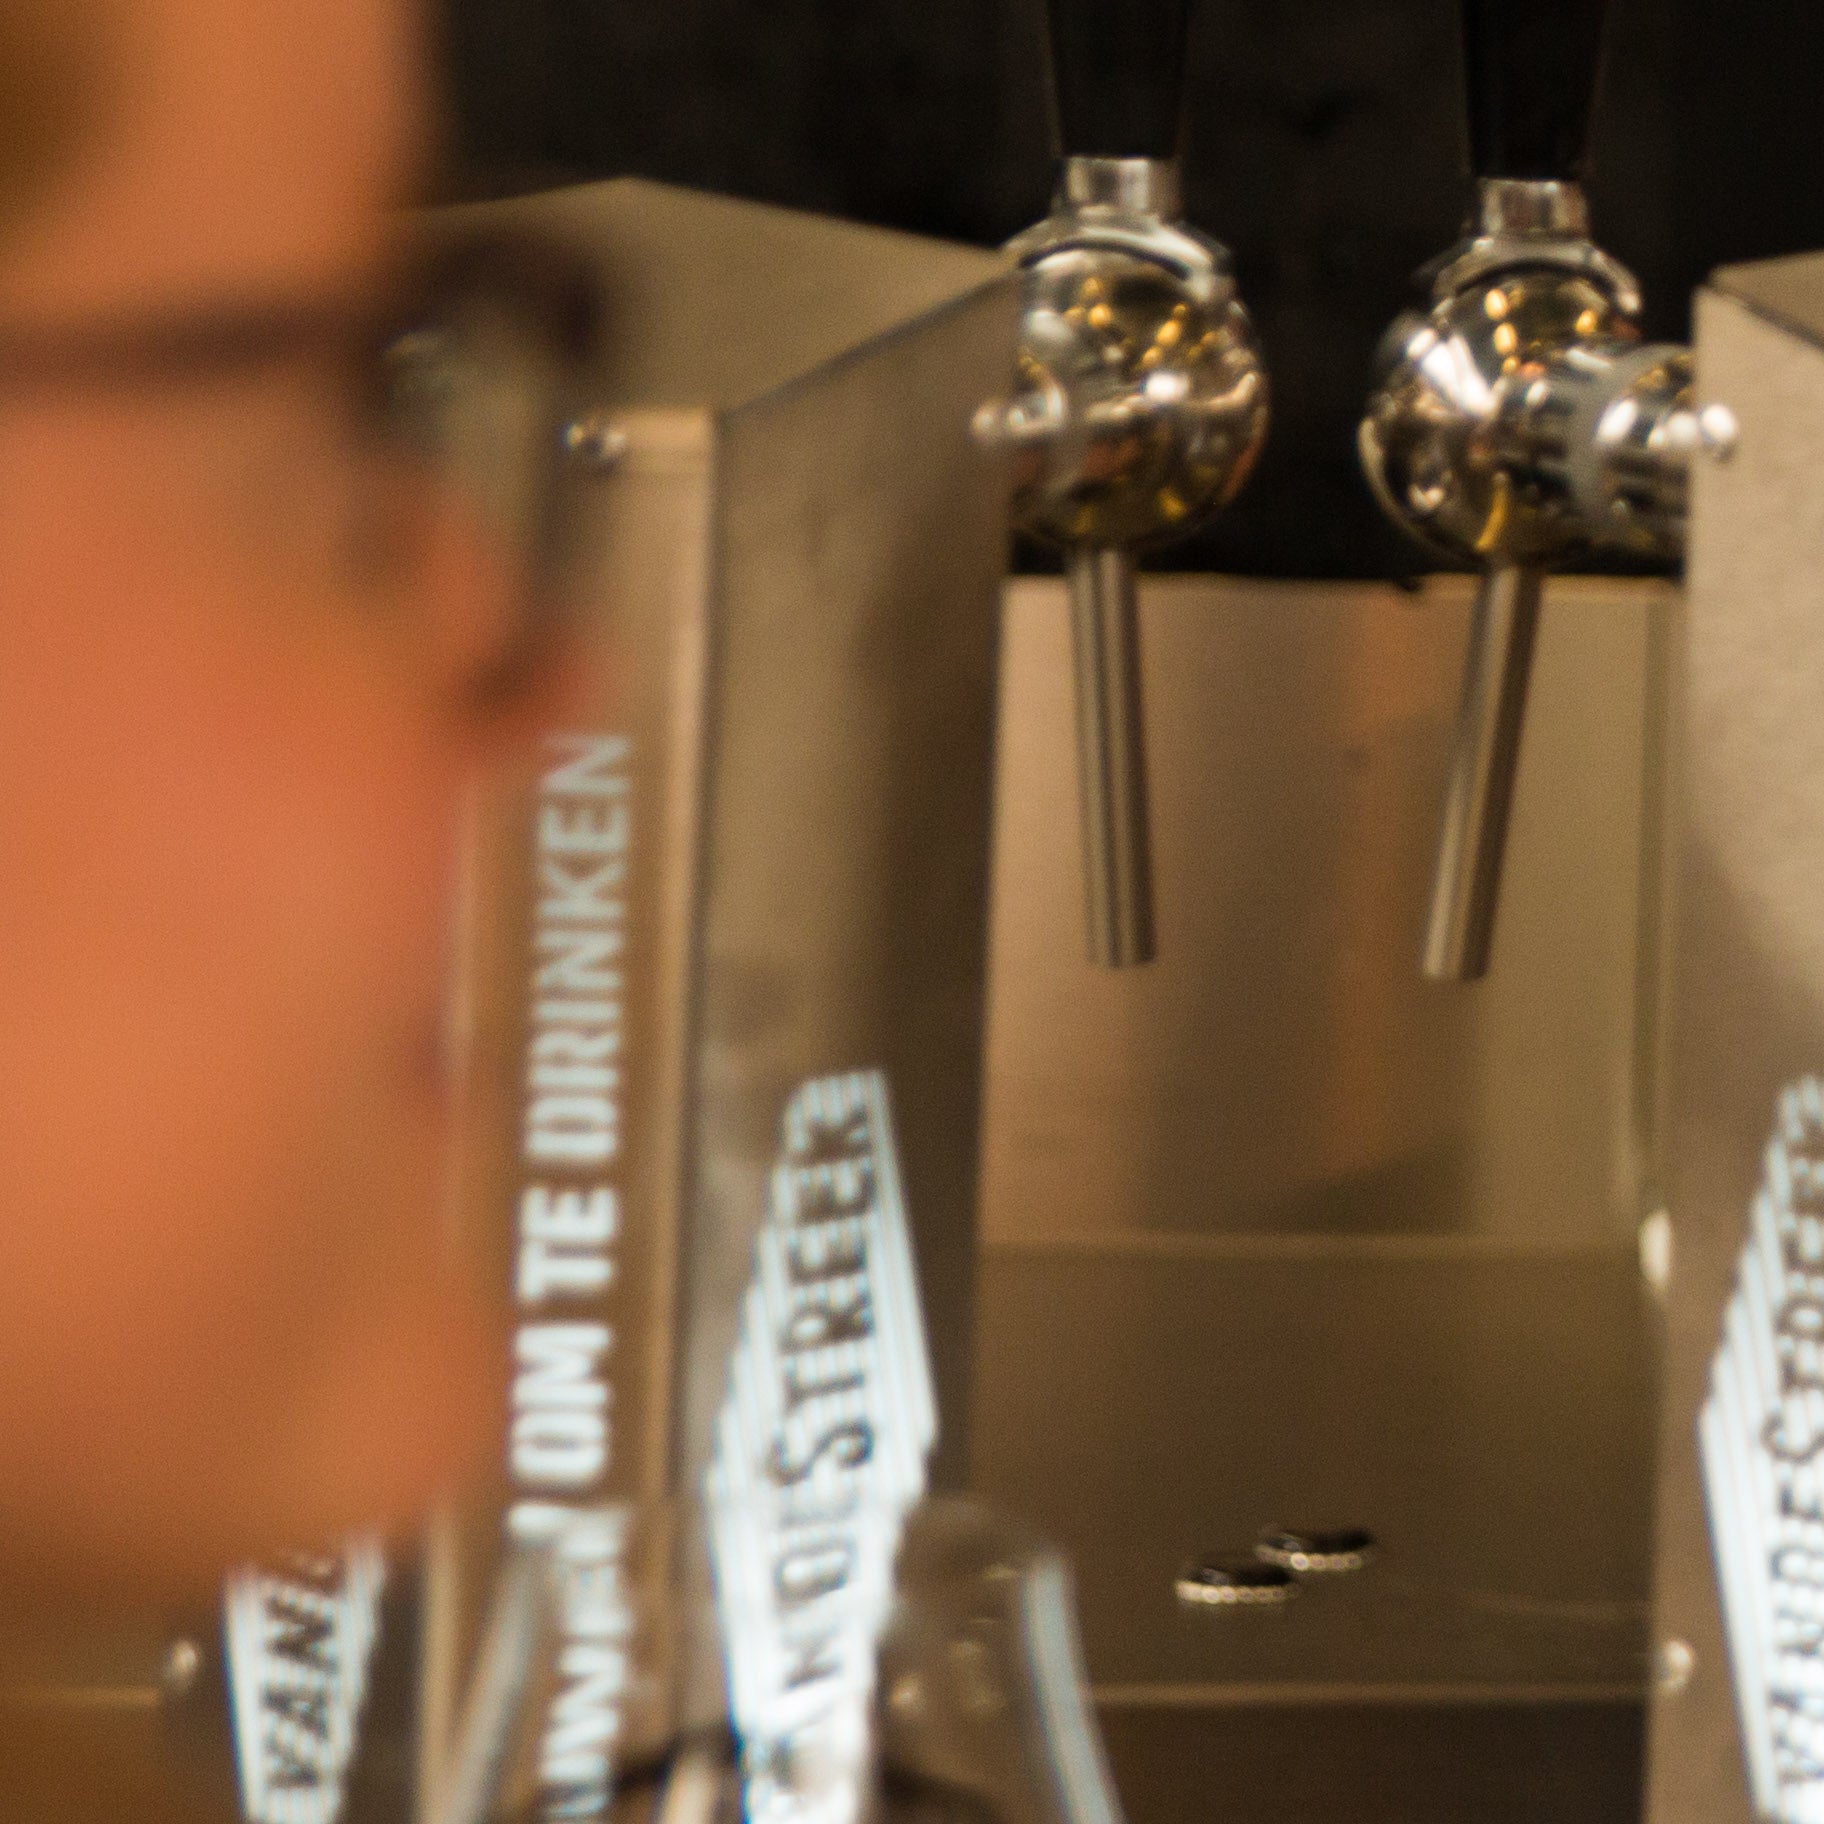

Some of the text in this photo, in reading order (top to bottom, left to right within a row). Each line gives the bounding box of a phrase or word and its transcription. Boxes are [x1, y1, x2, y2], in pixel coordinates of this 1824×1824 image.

[519, 734, 633, 1162] DRINKEN
[516, 1189, 618, 1301] TE
[509, 1326, 612, 1483] OM
